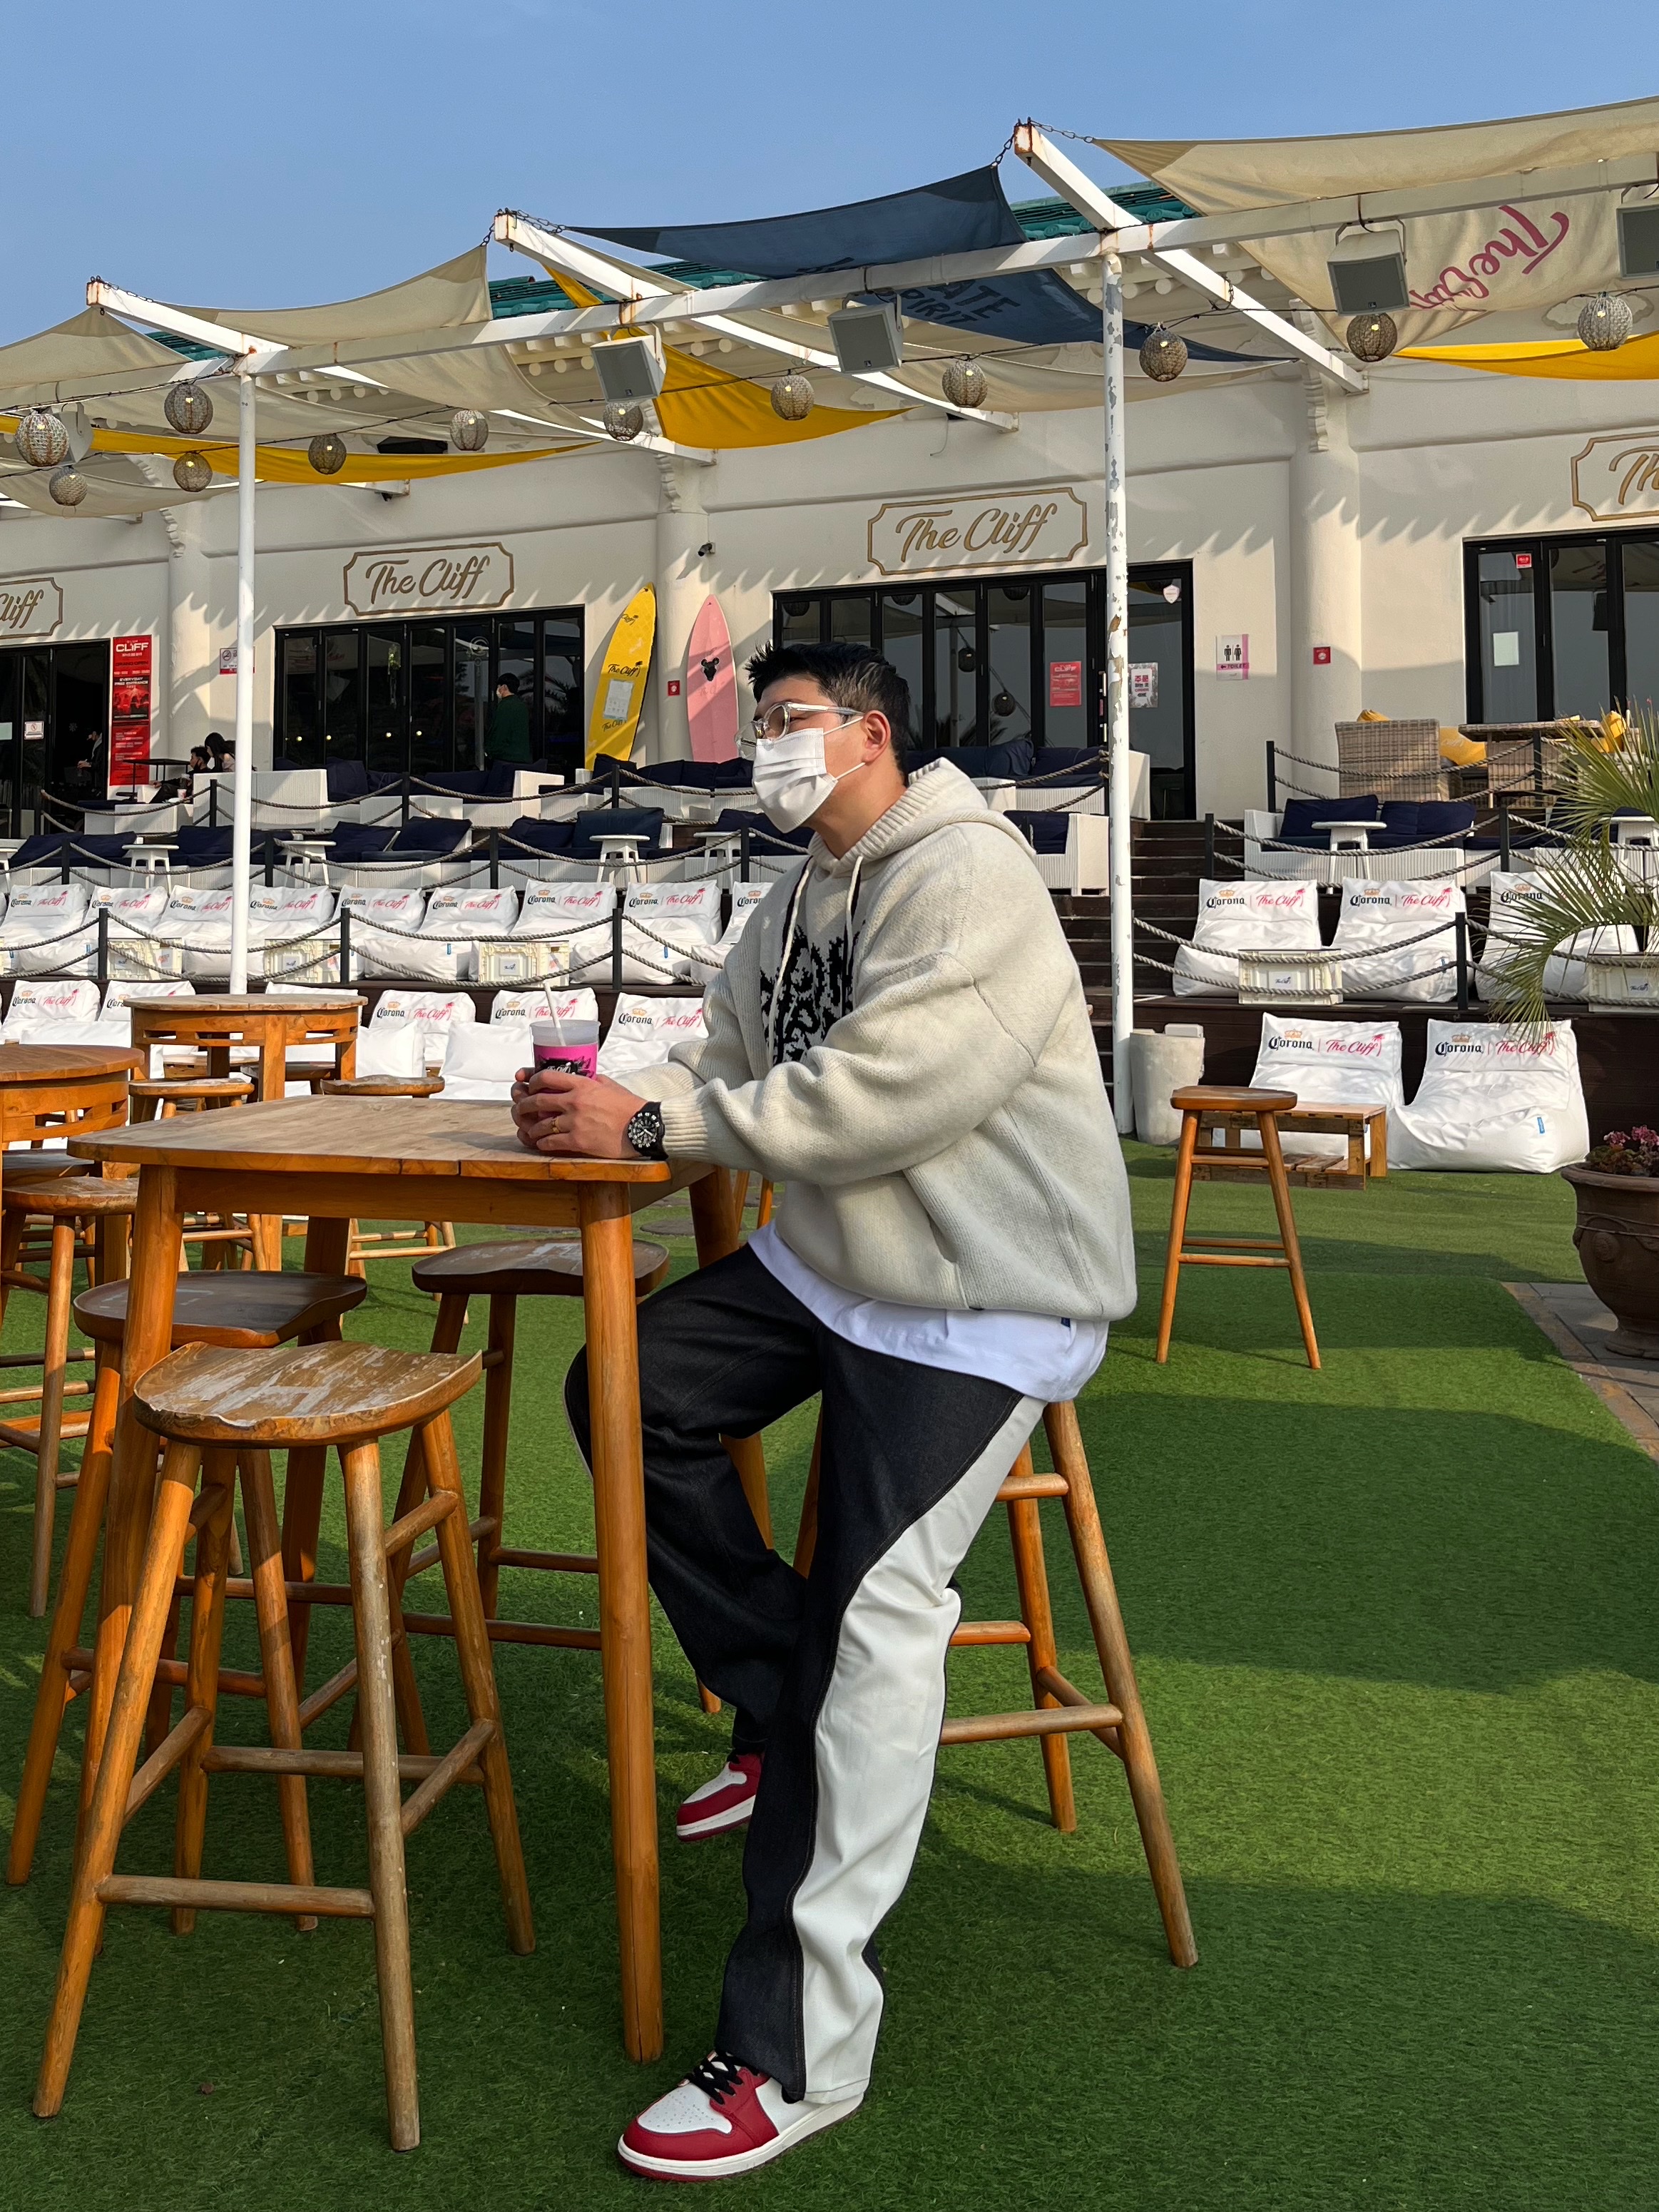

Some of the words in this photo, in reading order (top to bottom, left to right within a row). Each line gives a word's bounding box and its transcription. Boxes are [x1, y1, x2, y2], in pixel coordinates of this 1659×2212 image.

[1469, 204, 1569, 275] The
[1608, 445, 1659, 505] Th
[895, 509, 961, 563] The
[964, 503, 1058, 554] Cliff
[365, 559, 417, 605] The
[419, 555, 491, 600] Cliff
[116, 642, 149, 653] CLIFF
[528, 895, 556, 905] Corona
[629, 897, 658, 908] Corona
[666, 894, 680, 904] The
[737, 897, 760, 907] Coro
[1206, 896, 1245, 909] Corona
[1255, 894, 1275, 907] The
[1275, 895, 1300, 907] Cliff
[1349, 895, 1391, 907] Corona
[1401, 894, 1420, 907] The
[1420, 895, 1446, 907] Cliff
[377, 1007, 405, 1019] Corona
[495, 1007, 526, 1020] Corona
[534, 1006, 549, 1018] The
[618, 1013, 653, 1026] Corona
[661, 1016, 677, 1027] The
[677, 1015, 700, 1028] Cliff
[1268, 1036, 1313, 1051] Corona
[1325, 1039, 1347, 1053] The
[1347, 1041, 1378, 1056] Cliff
[1435, 1041, 1483, 1057] Corona
[1495, 1040, 1517, 1055] The
